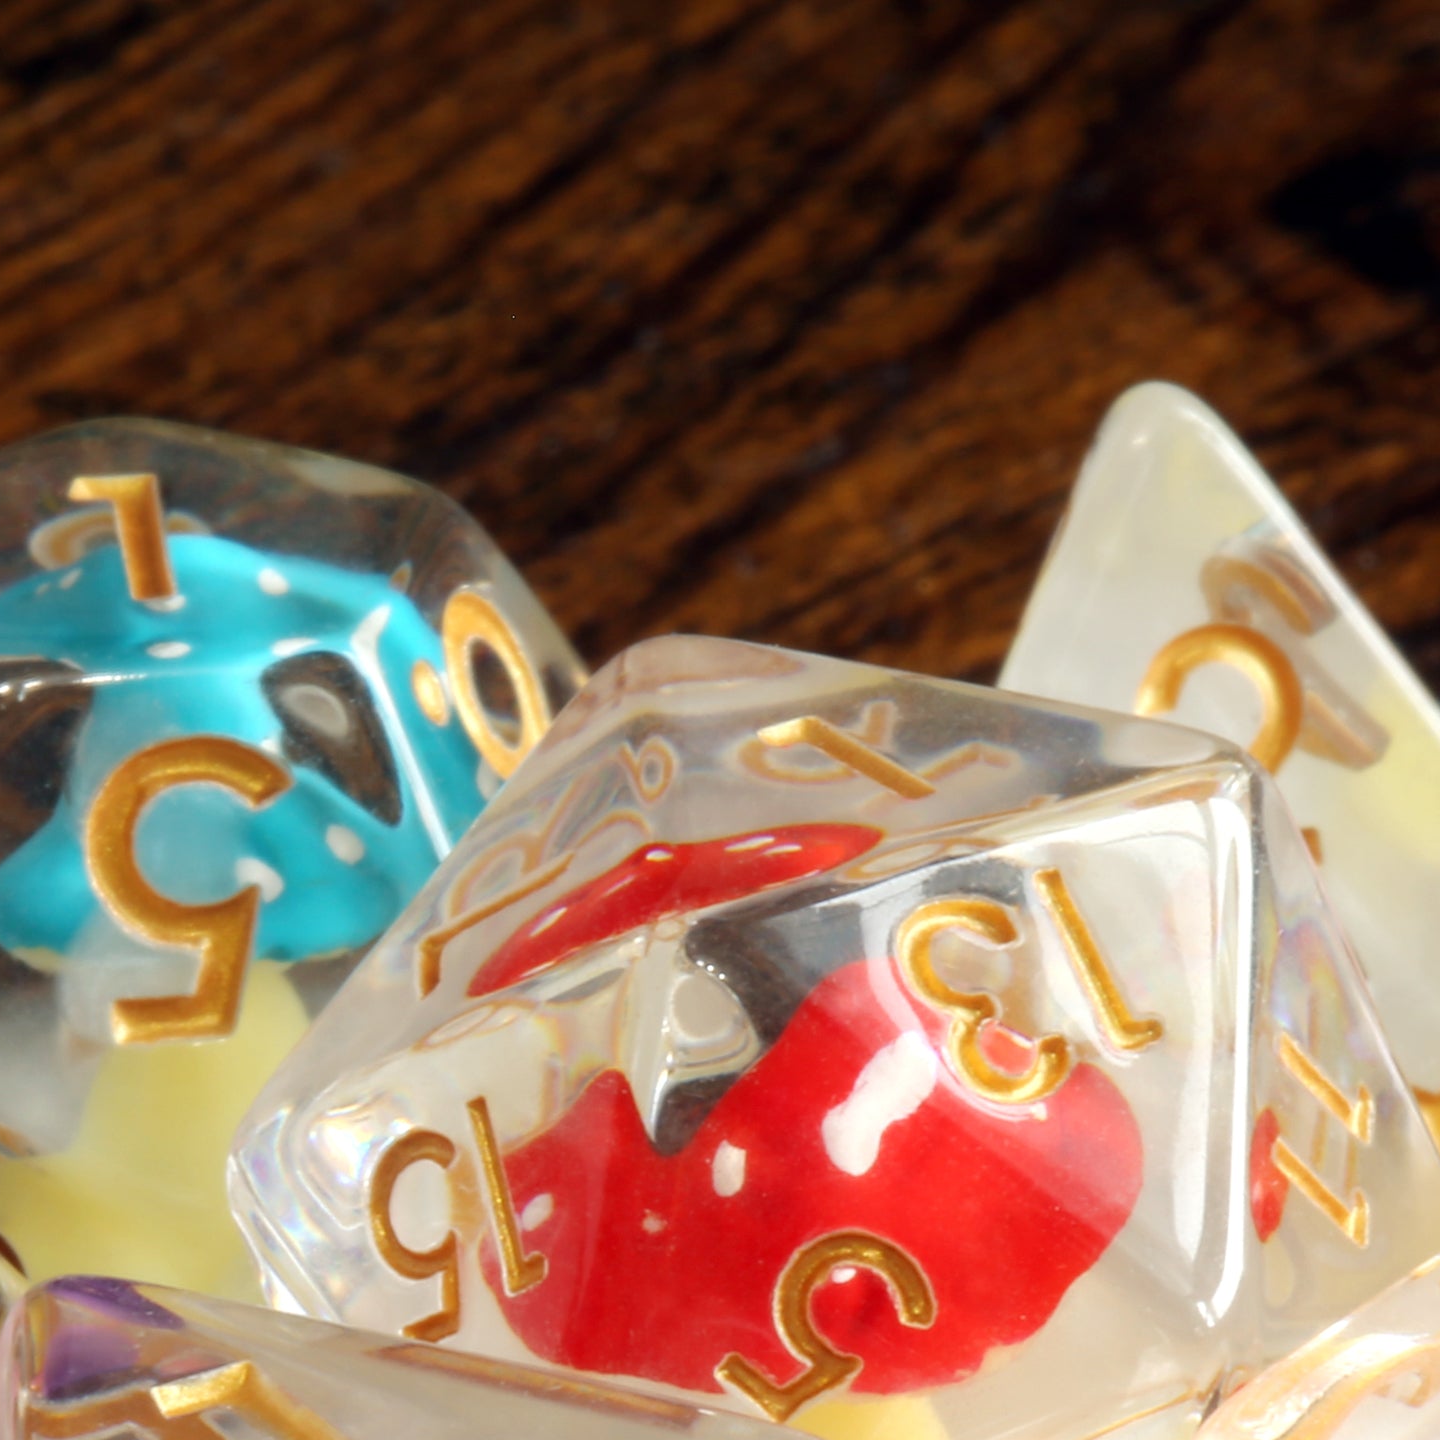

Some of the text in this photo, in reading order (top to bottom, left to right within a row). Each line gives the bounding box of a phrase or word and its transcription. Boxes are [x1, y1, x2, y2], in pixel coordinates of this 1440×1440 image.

[86, 734, 293, 1046] 5
[893, 866, 1162, 1105] 13
[369, 1096, 548, 1344] 15
[716, 1230, 938, 1423] 5
